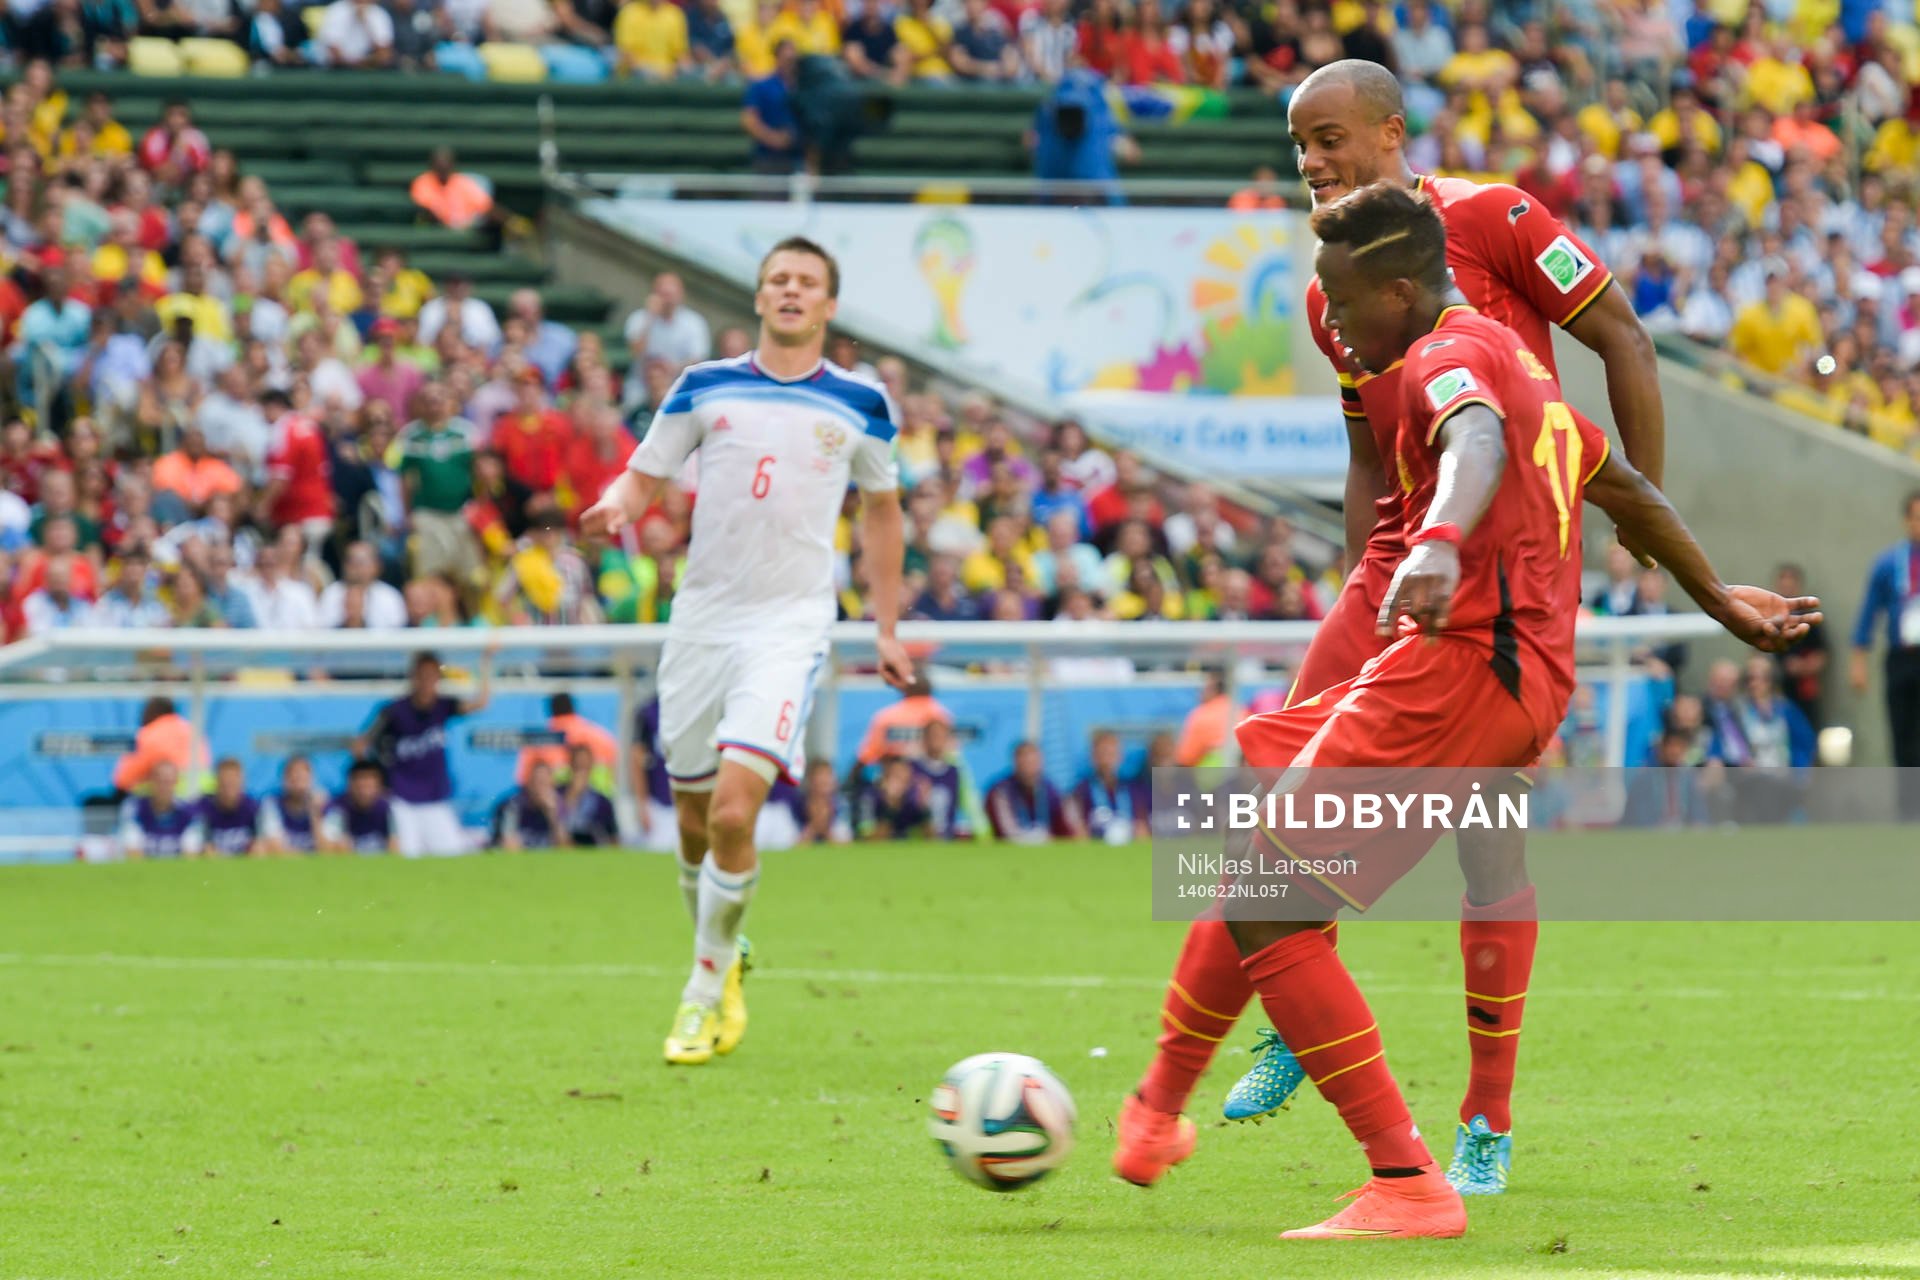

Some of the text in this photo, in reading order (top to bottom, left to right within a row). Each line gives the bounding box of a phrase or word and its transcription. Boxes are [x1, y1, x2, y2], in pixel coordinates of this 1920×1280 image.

[751, 455, 777, 500] 6
[1532, 401, 1584, 561] 17
[775, 699, 795, 742] 6
